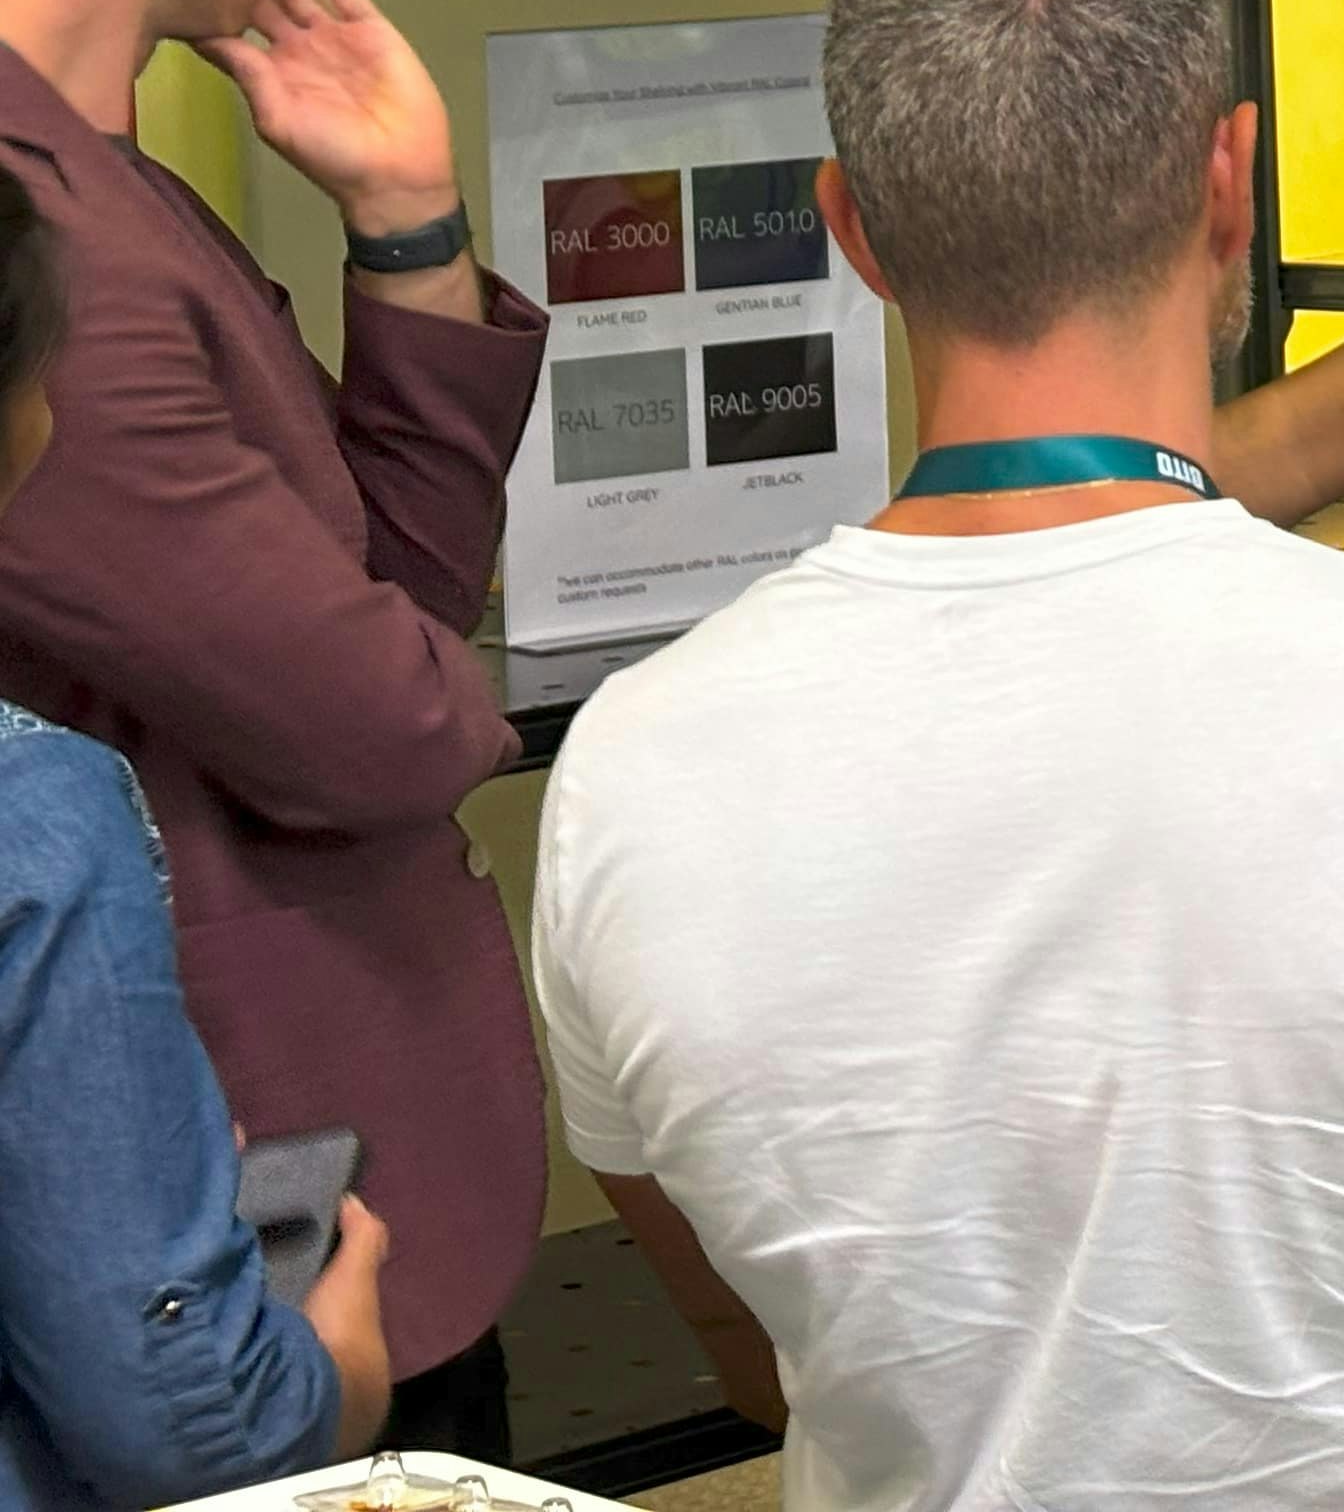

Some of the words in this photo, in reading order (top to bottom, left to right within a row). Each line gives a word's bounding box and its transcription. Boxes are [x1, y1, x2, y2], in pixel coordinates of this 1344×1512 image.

[551, 229, 598, 255] RAL
[606, 221, 671, 250] 3000
[699, 215, 745, 241] RAL
[753, 208, 816, 238] 5010
[716, 297, 770, 315] GENTIAN
[772, 294, 803, 309] BLUE
[576, 312, 620, 329] FLAME
[621, 309, 648, 326] RED
[709, 392, 755, 419] RAL
[761, 383, 823, 412] 9005
[558, 408, 606, 435] RAL
[612, 399, 676, 428] 7035
[742, 471, 804, 490] JETBLACK
[586, 489, 625, 509] LIGHT
[626, 487, 660, 503] GREY
